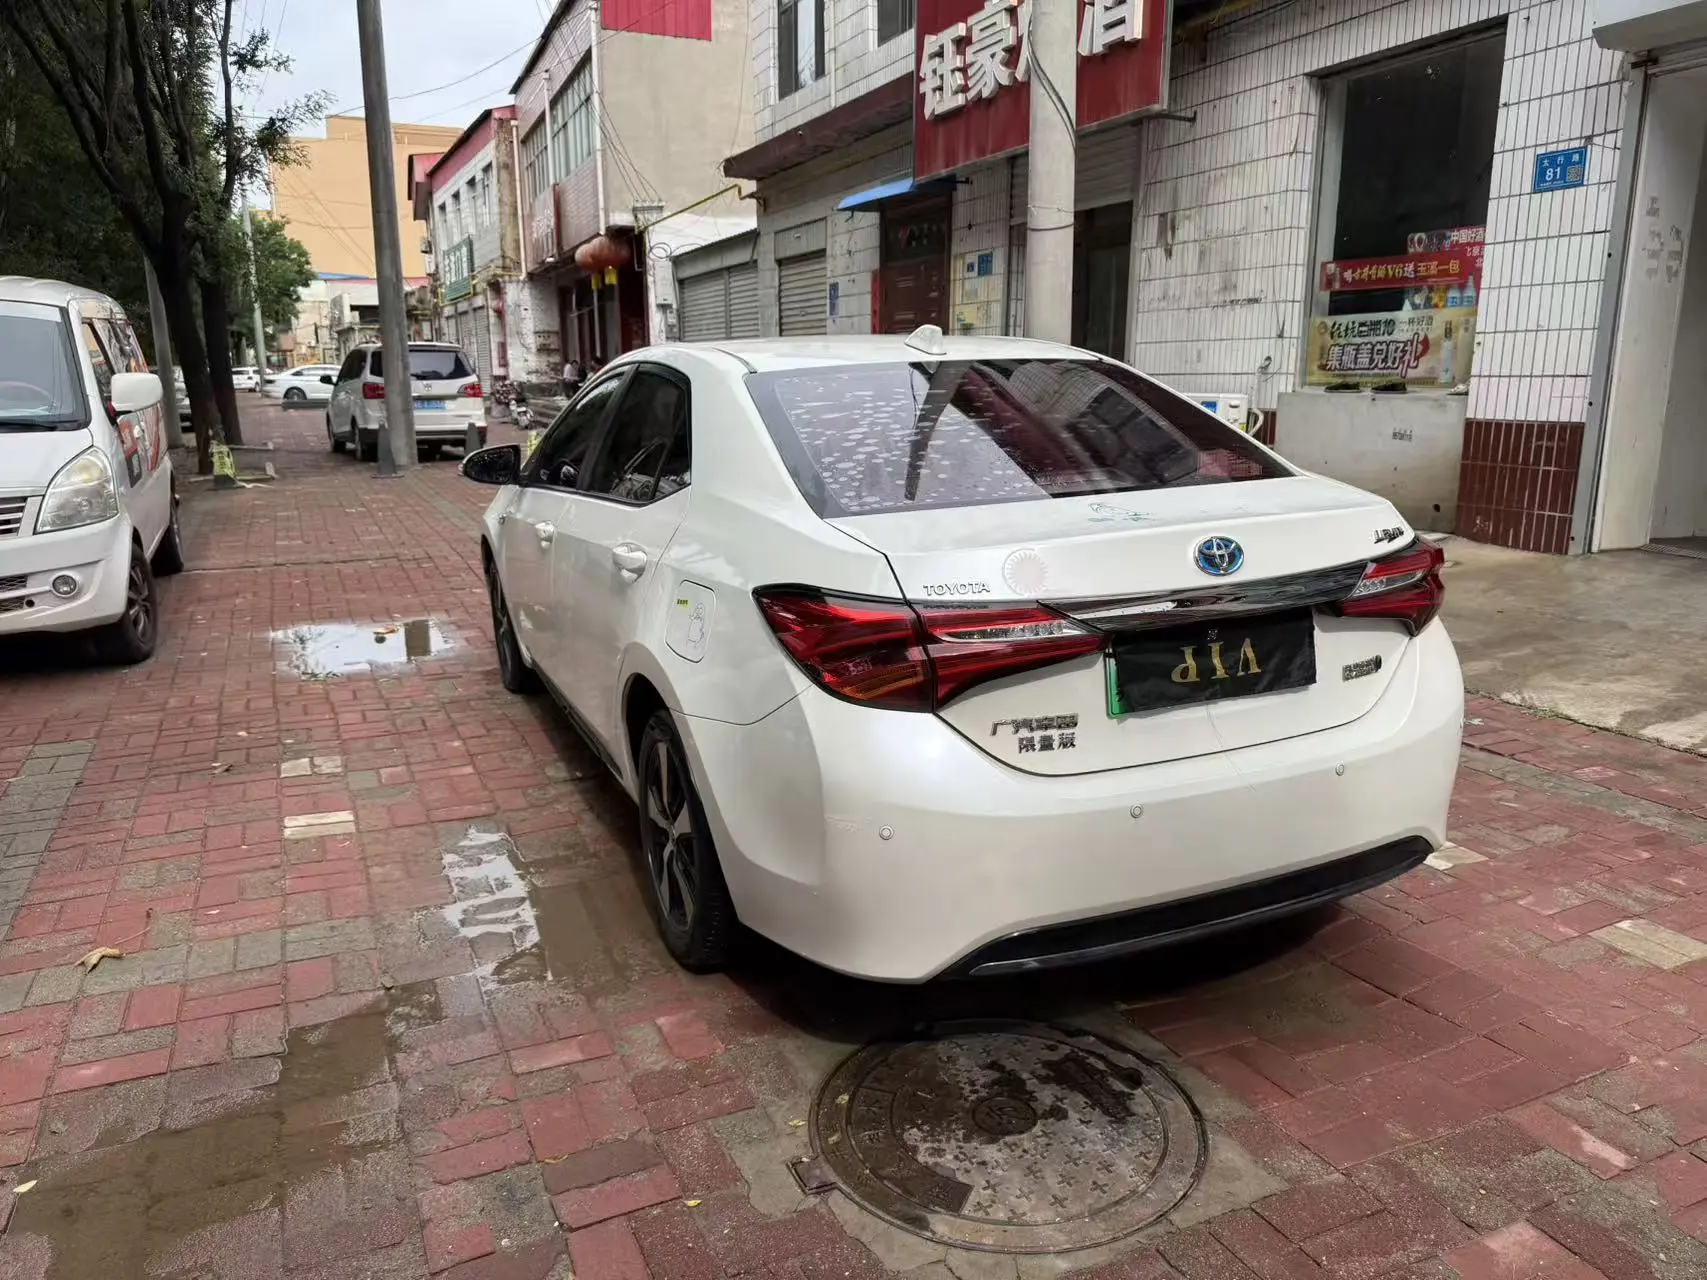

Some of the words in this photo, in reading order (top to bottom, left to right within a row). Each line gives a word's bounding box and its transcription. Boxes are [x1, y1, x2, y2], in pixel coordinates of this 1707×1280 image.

[1545, 166, 1561, 181] 81
[1325, 332, 1420, 378] 集瓶盖兑好礼
[922, 581, 991, 596] TOYOTA
[1171, 637, 1262, 683] VIP
[1017, 731, 1077, 754] 限量版
